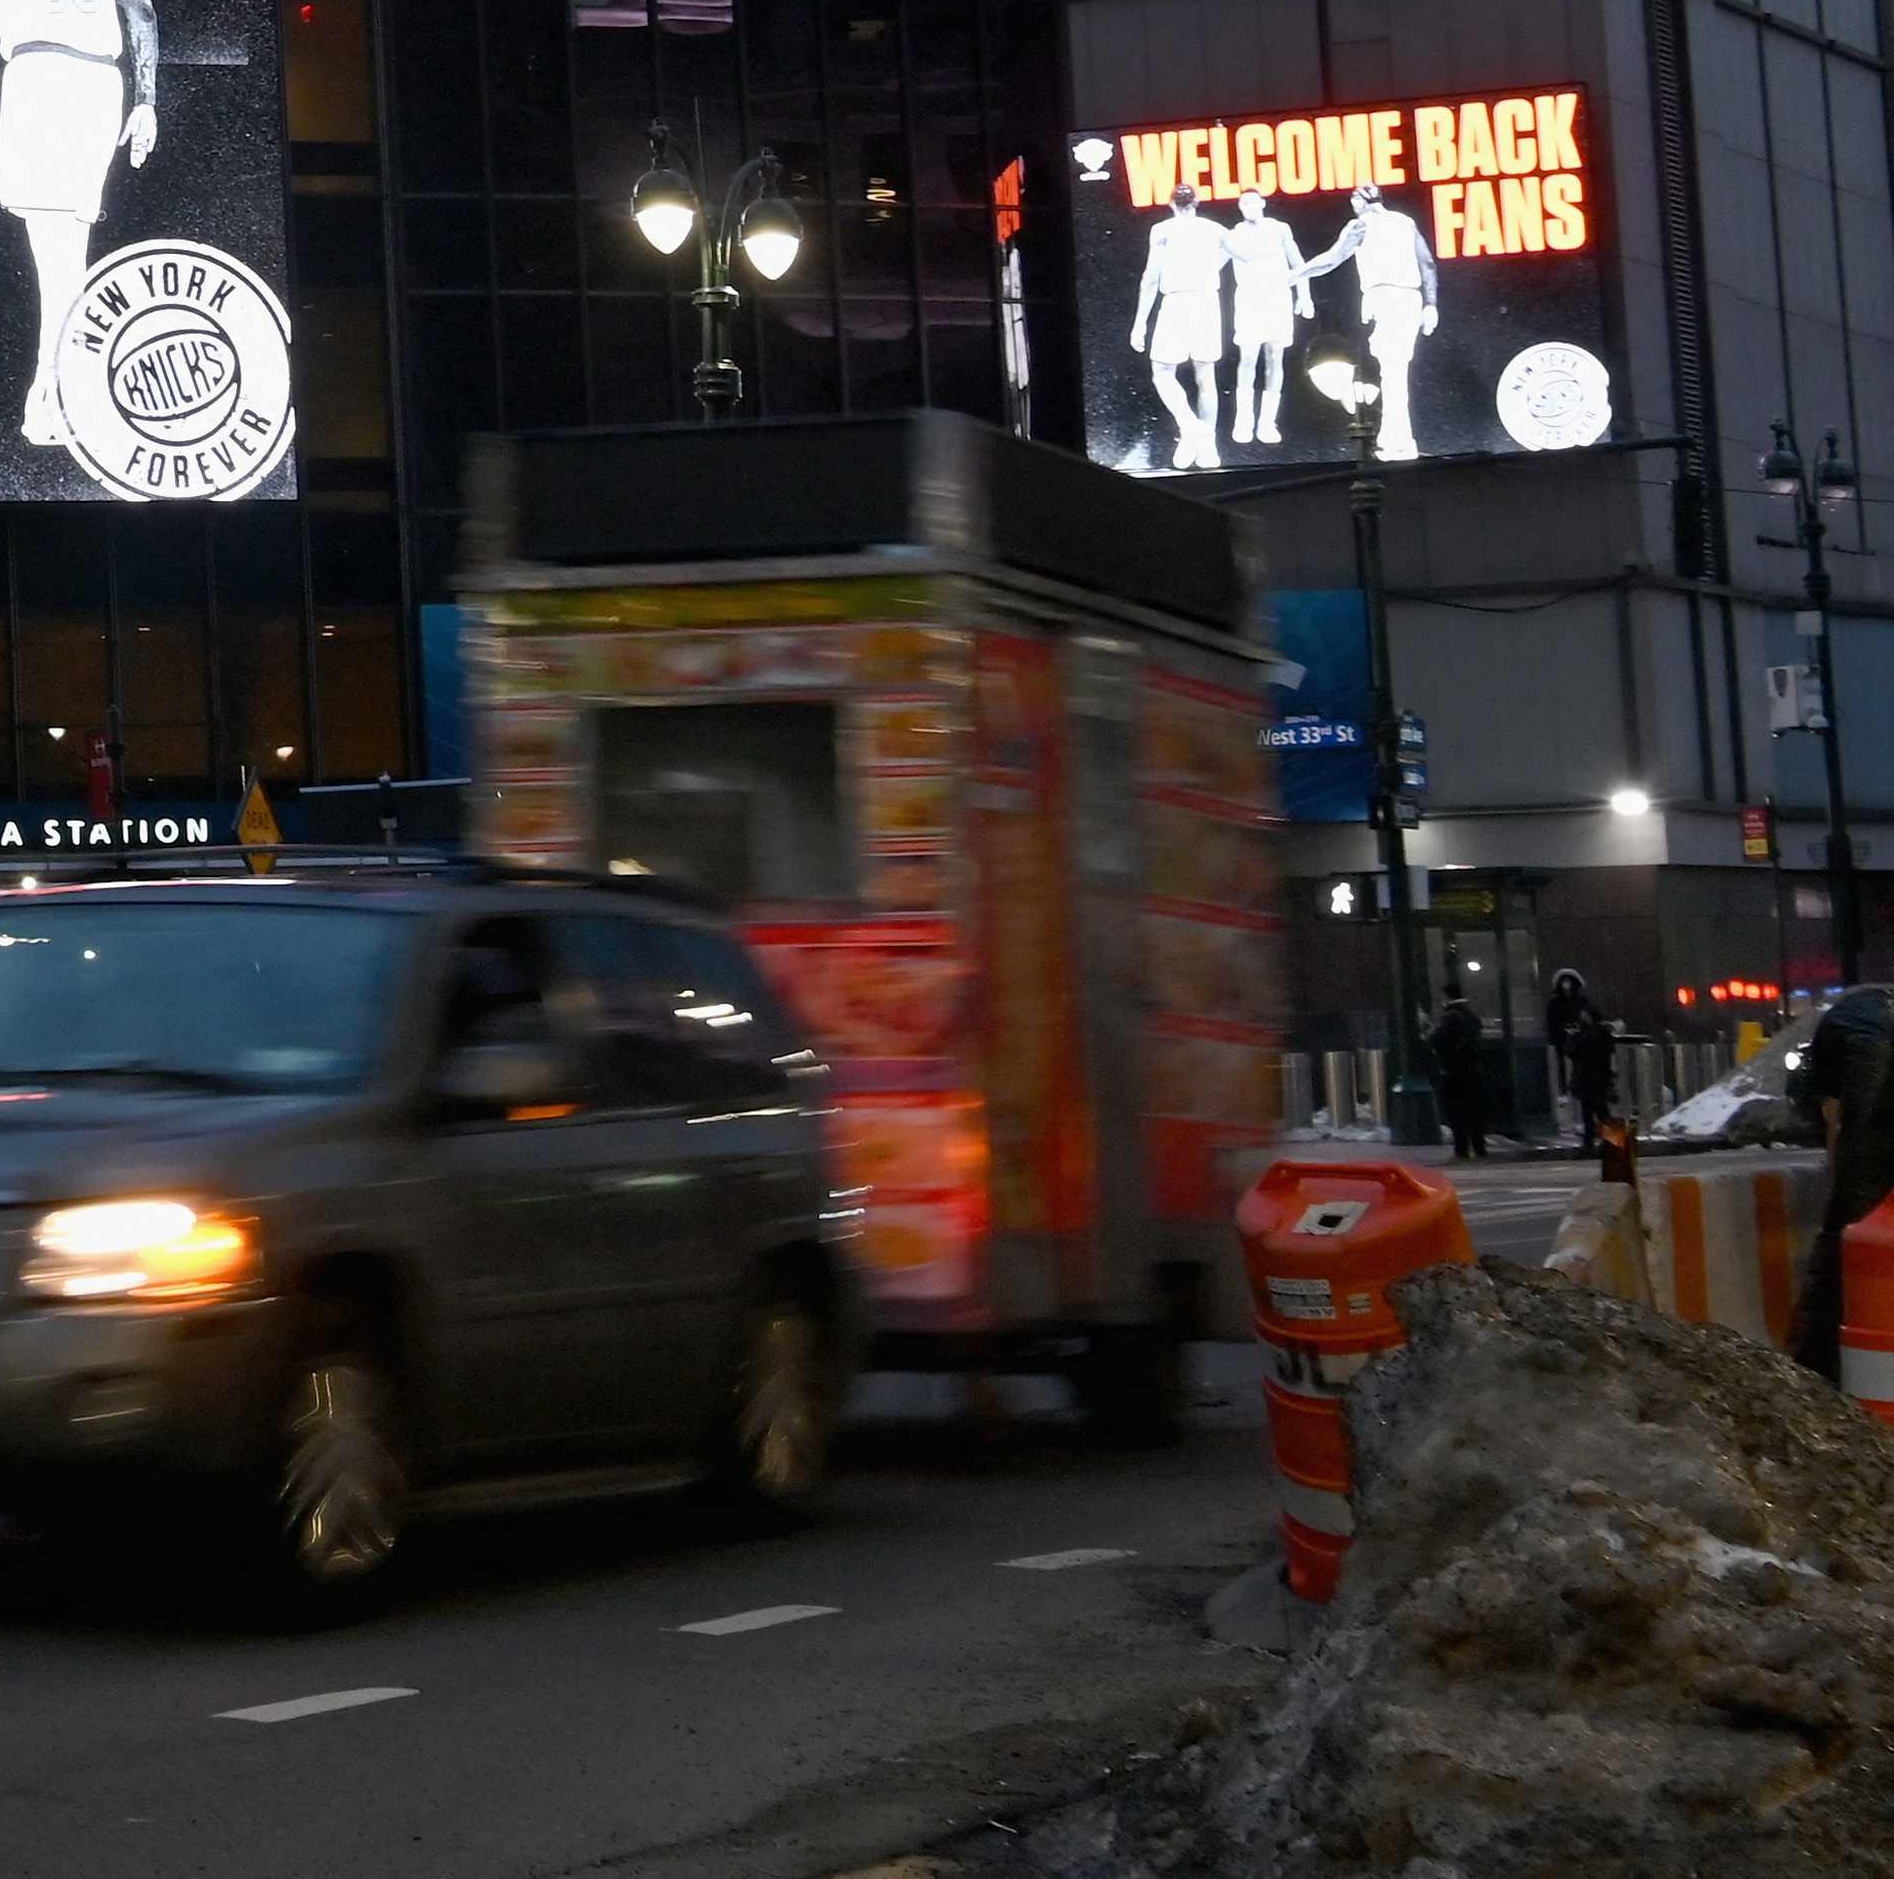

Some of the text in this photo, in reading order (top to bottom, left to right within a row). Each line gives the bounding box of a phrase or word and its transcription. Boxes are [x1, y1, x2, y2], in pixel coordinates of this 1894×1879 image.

[1120, 110, 1405, 207] WELCOME
[1414, 93, 1582, 181] BACK
[1432, 173, 1588, 259] FANS
[73, 262, 236, 354] NEW YORK
[124, 340, 226, 411] KNICKS
[125, 408, 271, 489] FOREVER
[1256, 728, 1297, 746] West
[1336, 724, 1356, 743] St
[43, 818, 208, 847] STATION
